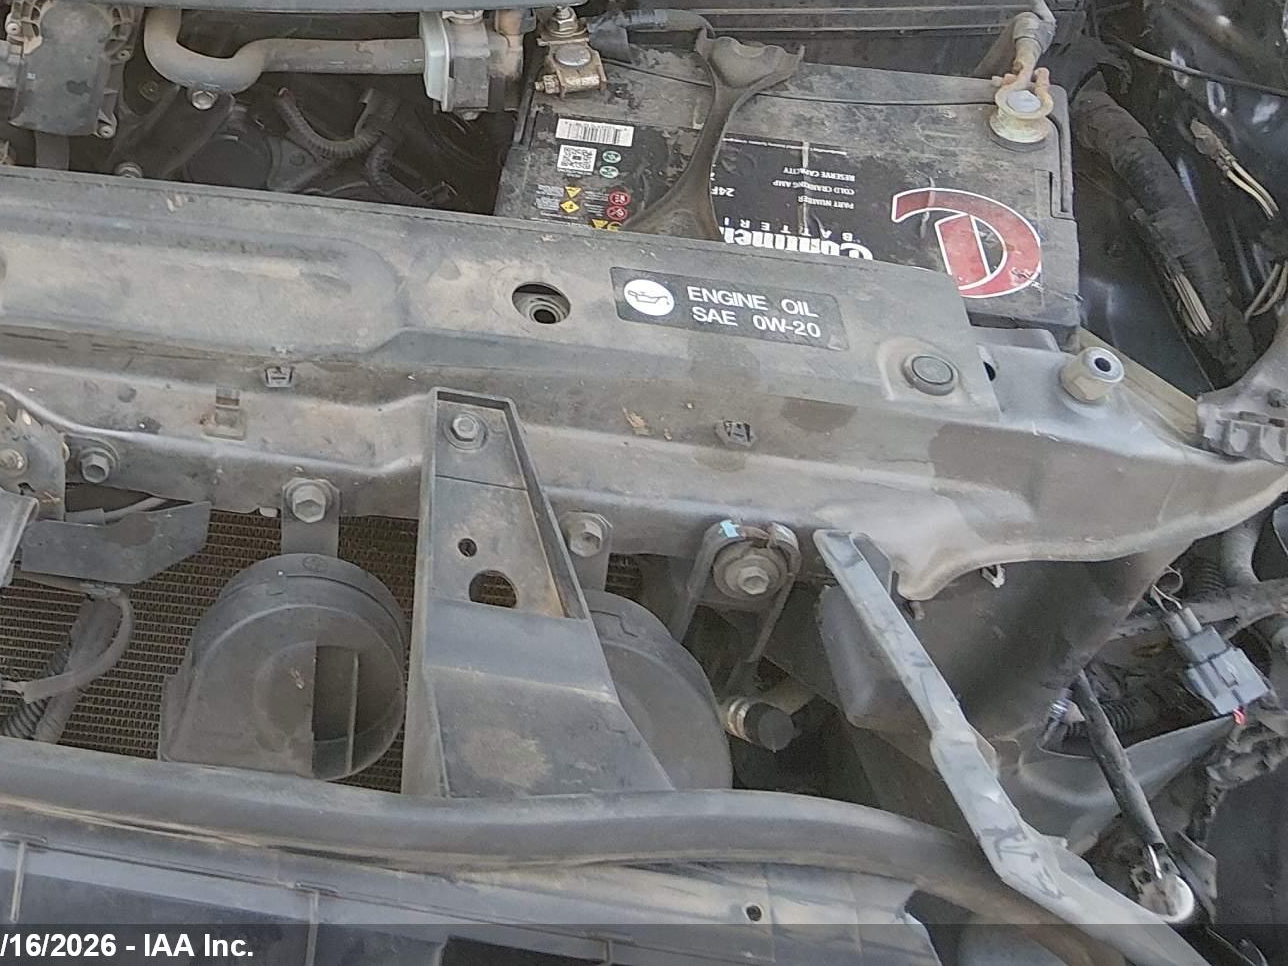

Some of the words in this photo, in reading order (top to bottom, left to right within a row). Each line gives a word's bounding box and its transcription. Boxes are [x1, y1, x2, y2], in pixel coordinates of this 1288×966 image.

[783, 166, 820, 178] CAPACITY
[820, 171, 856, 182] RESERVE
[772, 179, 792, 187] AMP
[792, 181, 833, 193] CRANKING
[833, 187, 856, 196] COLD
[797, 195, 833, 208] NUMBER
[833, 200, 855, 210] PART
[687, 285, 769, 311] ENGINE
[781, 298, 820, 318] OIL
[691, 306, 738, 327] SAE
[752, 314, 822, 338] 0W-20
